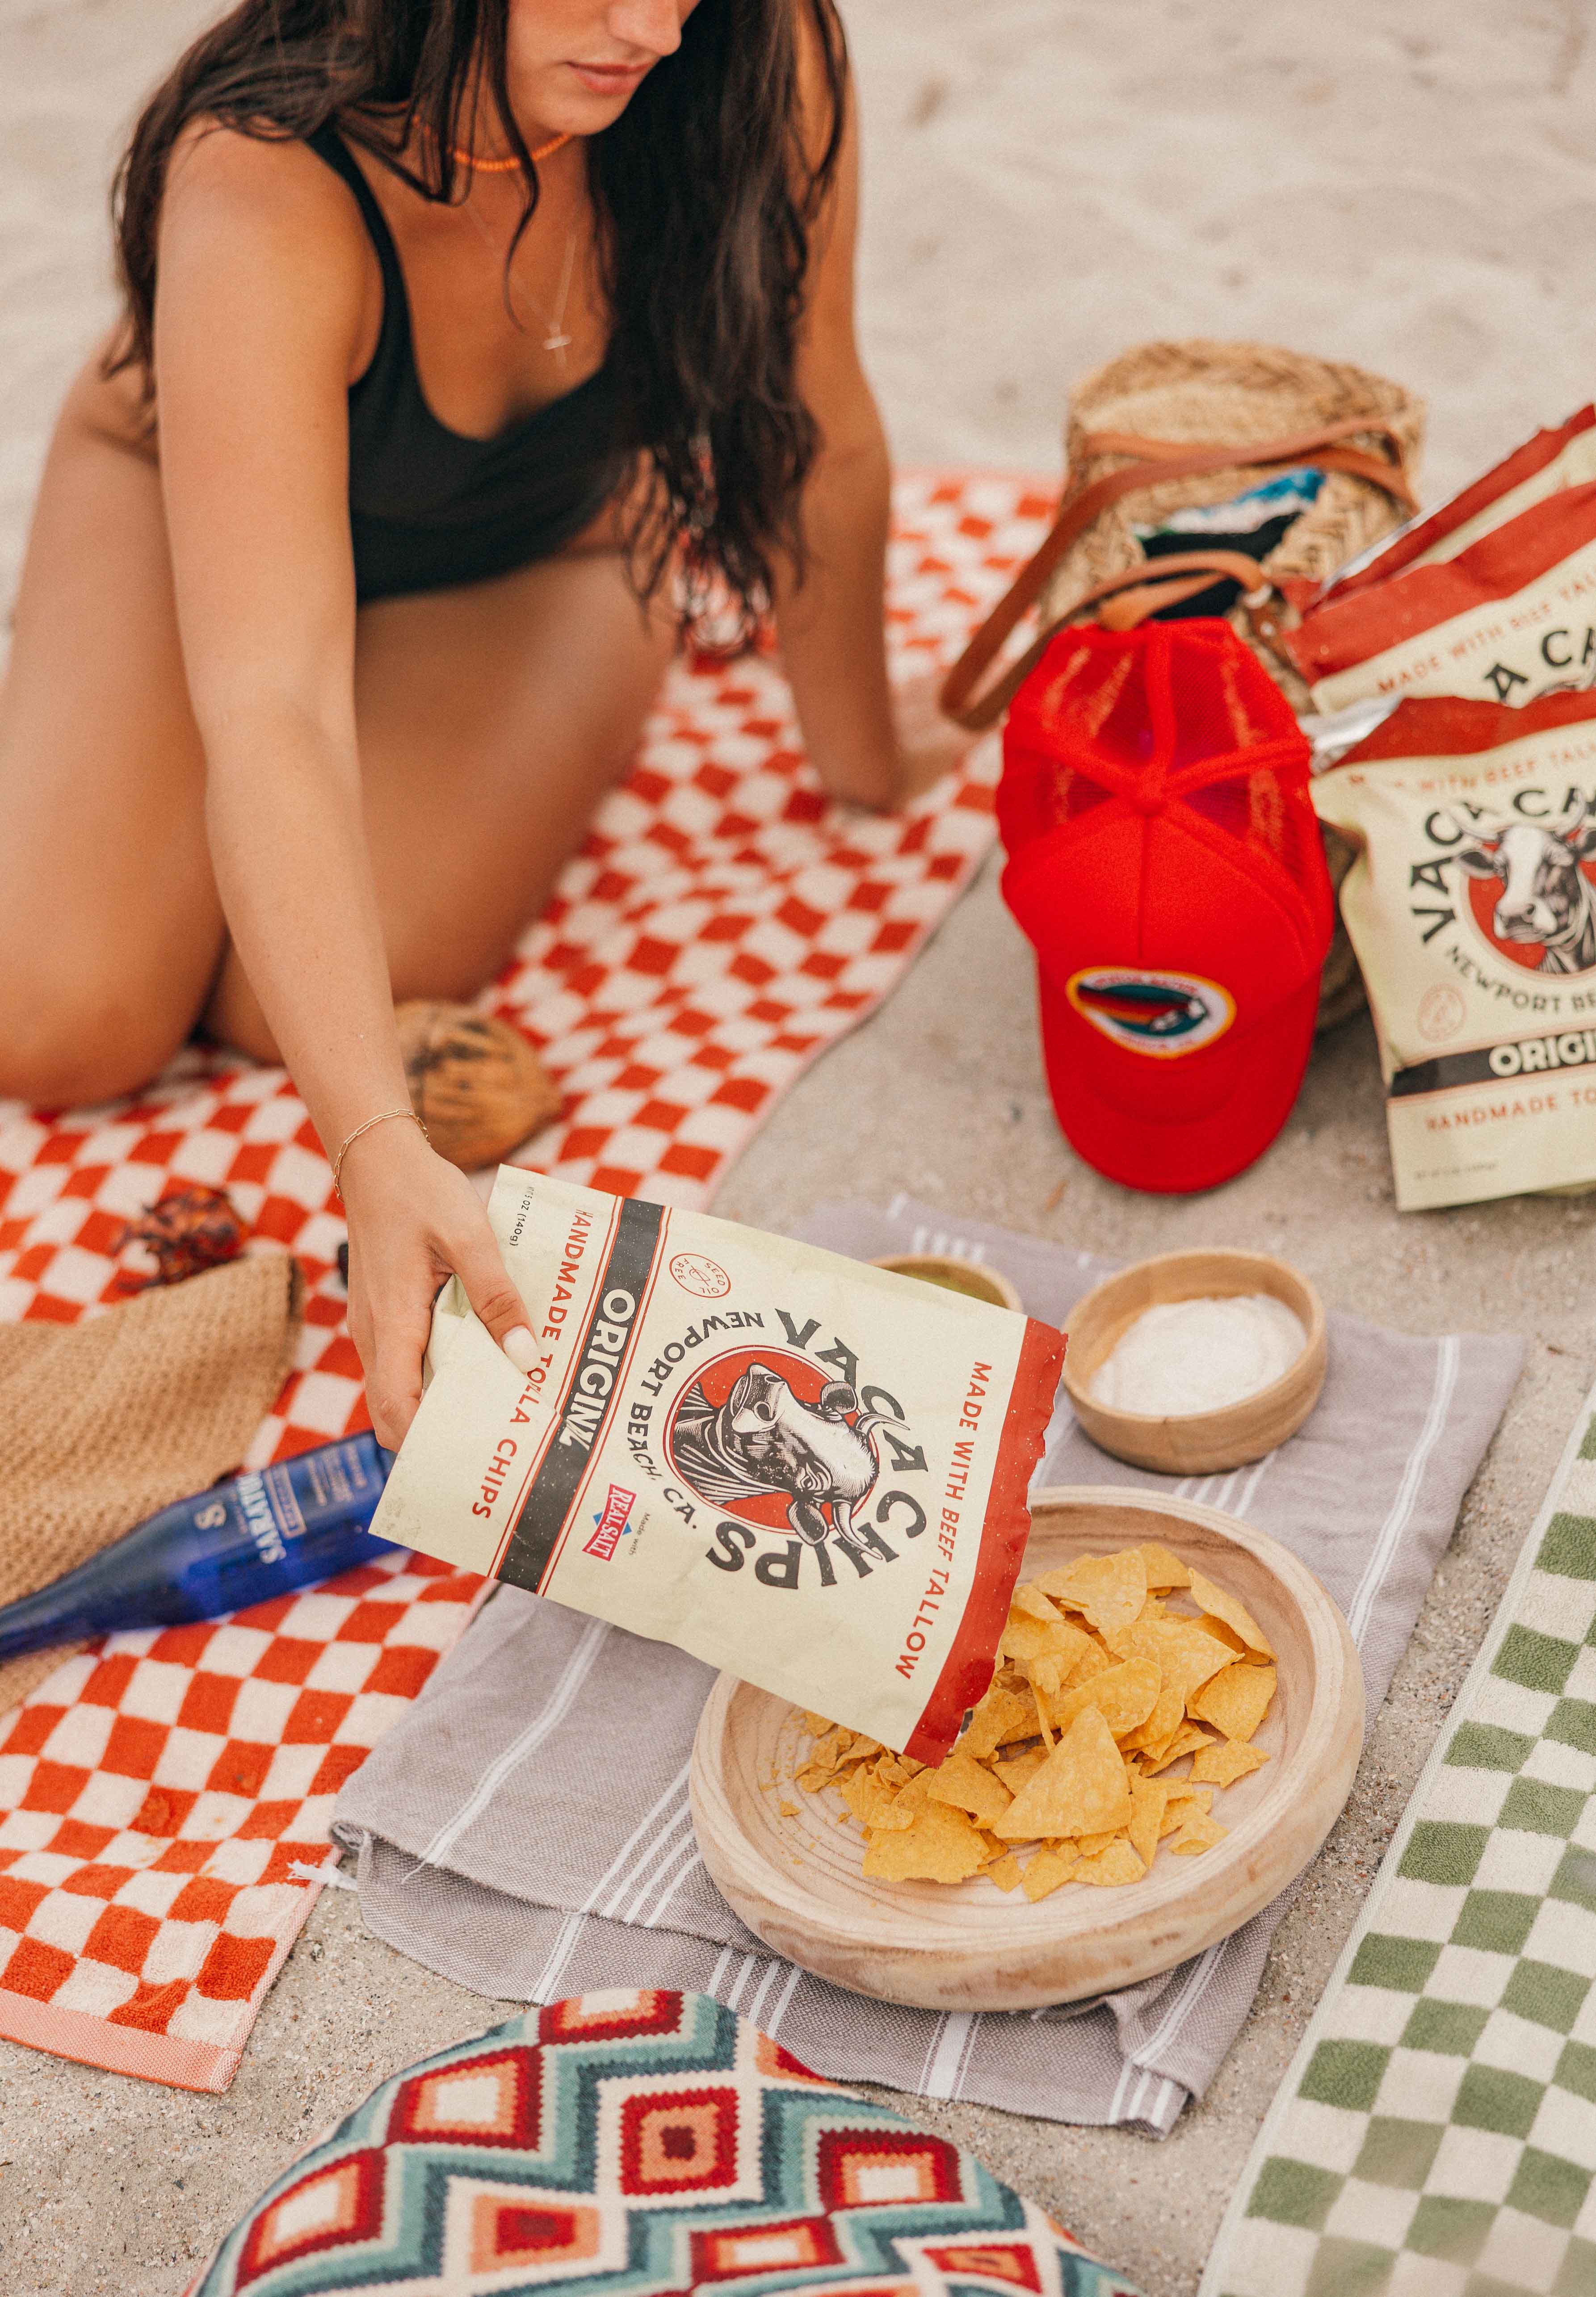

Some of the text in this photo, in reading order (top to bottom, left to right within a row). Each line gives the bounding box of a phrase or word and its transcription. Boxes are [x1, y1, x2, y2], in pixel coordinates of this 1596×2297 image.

[1489, 1029, 1596, 1077] ORIGI
[521, 1200, 531, 1211] OZ
[509, 1213, 527, 1247] (140g)
[542, 1209, 594, 1341] HANDMADE
[675, 1258, 690, 1280] FREE
[704, 1263, 726, 1286] SEED
[641, 1311, 765, 1397] NEWPORT
[705, 1308, 928, 1590] VACA CHIPS
[472, 1438, 518, 1519] CHIPS
[629, 1512, 651, 1556] Made with
[895, 1361, 992, 1680] MADE WITH BEEF TALLOW
